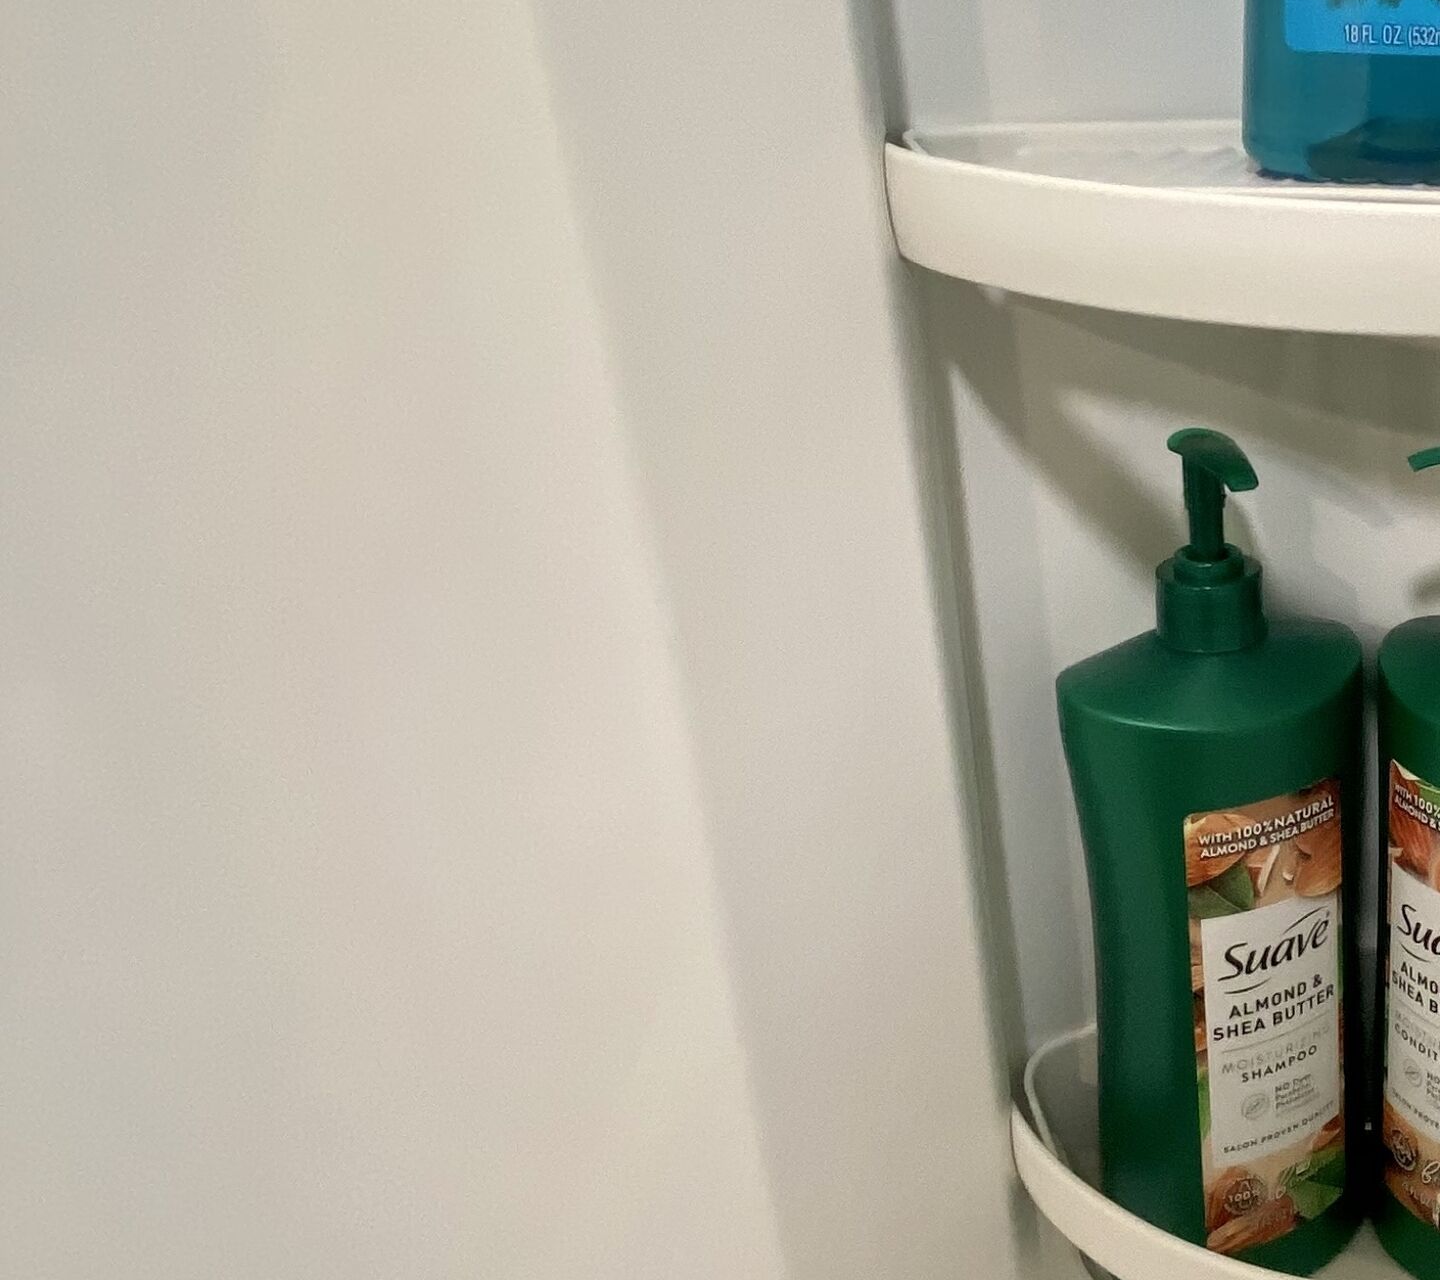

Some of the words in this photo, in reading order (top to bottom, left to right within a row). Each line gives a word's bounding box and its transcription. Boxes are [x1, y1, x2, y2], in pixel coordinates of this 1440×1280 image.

[1345, 24, 1359, 43] 18
[1362, 24, 1378, 44] FL
[1383, 24, 1405, 45] OZ
[1199, 831, 1232, 846] WITH
[1235, 820, 1273, 840] 100%
[1274, 795, 1334, 830] NATURAL
[1394, 795, 1429, 824] ALMOND
[1429, 819, 1437, 829] &
[1201, 838, 1257, 858] ALMOND
[1259, 835, 1268, 846] &
[1270, 827, 1299, 844] SHEA
[1300, 808, 1334, 832] BUTTER
[1217, 914, 1330, 982] Suave
[1229, 982, 1307, 1019] ALMOND
[1312, 974, 1322, 988] &
[1392, 970, 1424, 1007] SHEA
[1213, 1018, 1265, 1041] SHEA
[1272, 984, 1334, 1026] BUTTER
[1241, 1045, 1318, 1083] SHAMPOO
[1223, 1138, 1257, 1153] SALON
